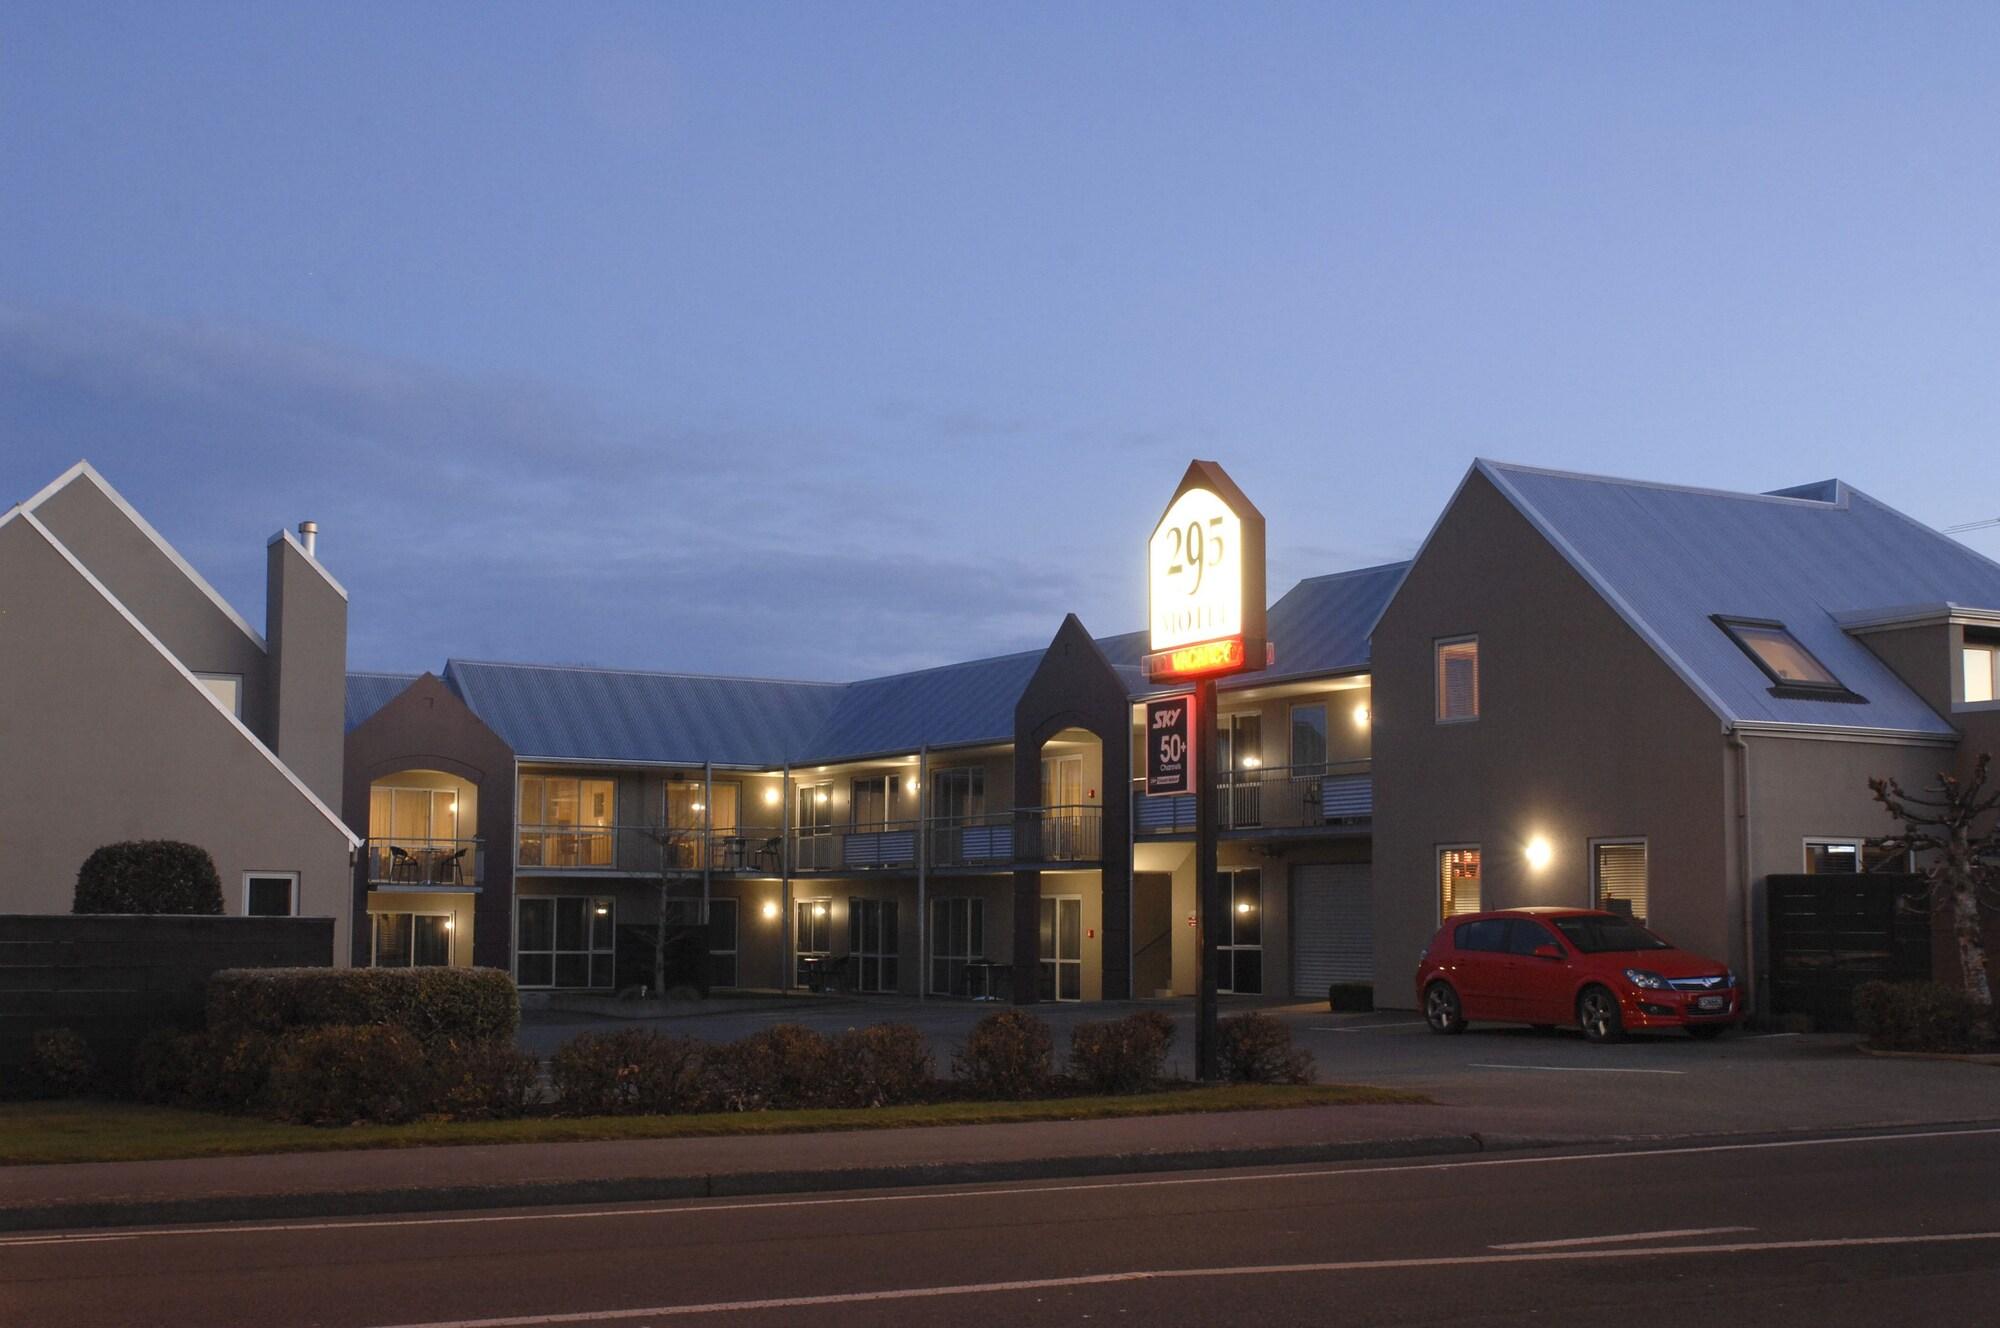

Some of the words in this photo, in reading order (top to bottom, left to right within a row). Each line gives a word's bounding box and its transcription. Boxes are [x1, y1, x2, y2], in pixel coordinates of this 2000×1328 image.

[1166, 516, 1224, 596] 295
[1152, 708, 1181, 729] SKY
[1160, 733, 1187, 763] 50+
